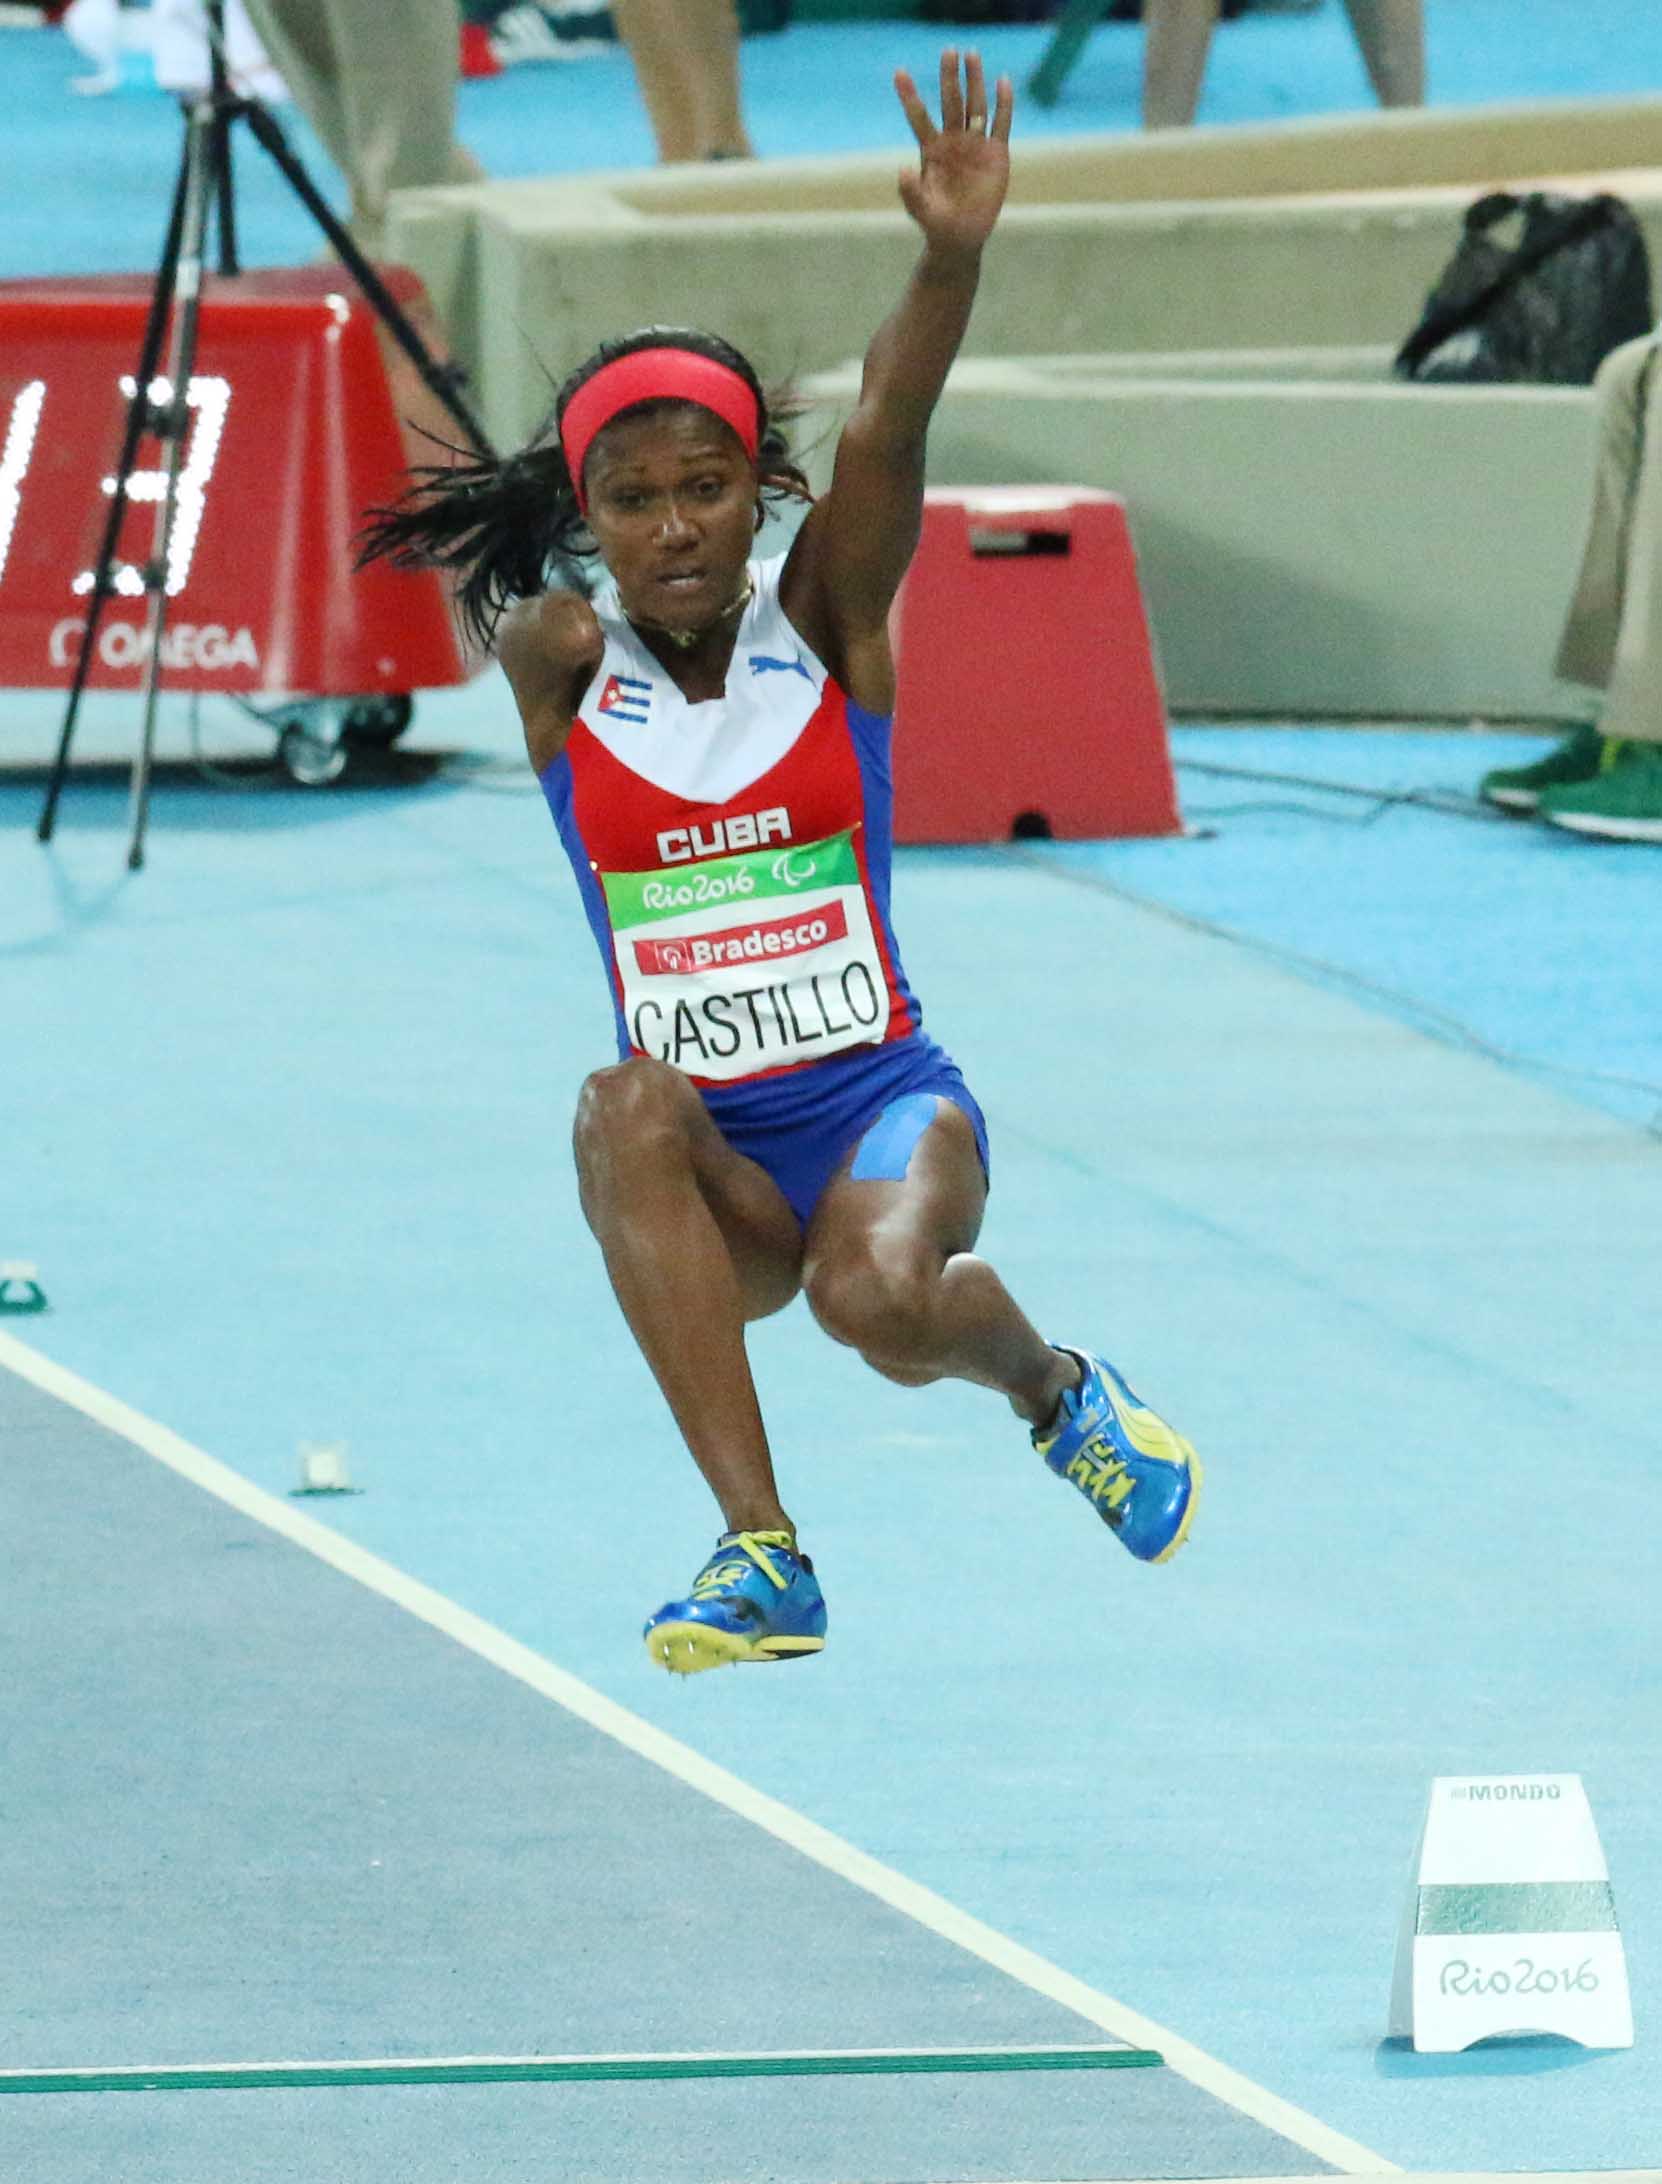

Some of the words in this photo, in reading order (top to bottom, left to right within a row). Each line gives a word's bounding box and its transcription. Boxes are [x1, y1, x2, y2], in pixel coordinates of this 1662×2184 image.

[655, 806, 792, 863] CUBA
[691, 917, 828, 966] Bradesco
[633, 960, 880, 1064] CASTILLO
[1468, 1783, 1562, 1801] MONDO
[1439, 1958, 1600, 1997] Rio2016
